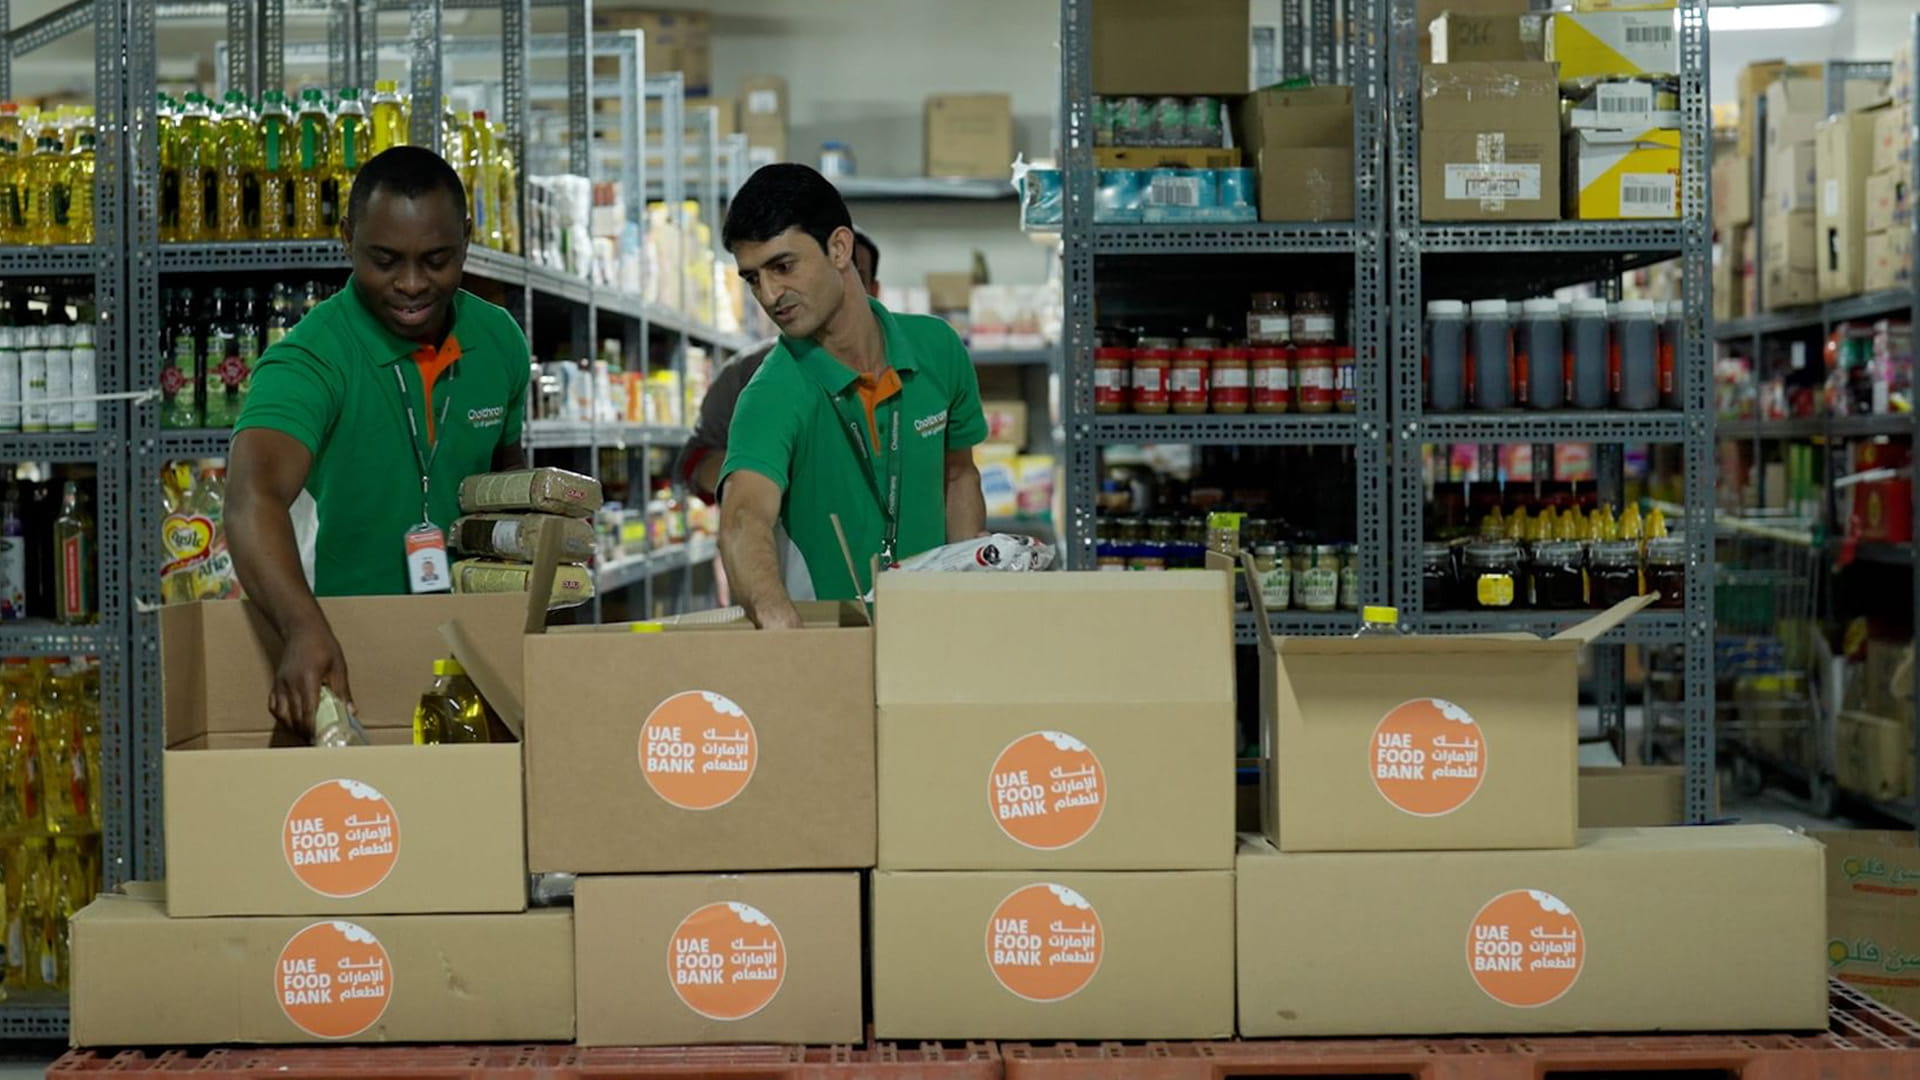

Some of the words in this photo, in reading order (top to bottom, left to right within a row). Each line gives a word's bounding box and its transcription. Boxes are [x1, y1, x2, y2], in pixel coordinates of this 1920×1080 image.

[648, 726, 682, 743] UAE
[703, 728, 749, 743] بنك
[1378, 733, 1412, 749] UAE
[1433, 735, 1478, 750] بنك
[648, 742, 696, 758] FOOD
[702, 742, 749, 761] الإمارات
[1378, 748, 1425, 764] FOOD
[1432, 749, 1478, 767] الإمارات
[648, 757, 694, 773] BANK
[702, 758, 748, 773] للطعام
[1377, 763, 1424, 780] BANK
[1432, 764, 1478, 780] للطعام
[994, 770, 1029, 791] UAE
[1050, 765, 1095, 783] بنك
[997, 784, 1045, 806] FOOD
[1051, 775, 1097, 798] الإمارات
[999, 798, 1047, 819] BANK
[1054, 791, 1099, 812] للطعام
[290, 818, 324, 836] UAE
[345, 813, 390, 827] بنك
[292, 832, 339, 852] FOOD
[346, 824, 391, 846] الإمارات
[293, 846, 341, 866] BANK
[348, 840, 393, 859] للطعام
[995, 919, 1028, 935] UAE
[1050, 920, 1095, 936] بنك
[1475, 925, 1509, 942] UAE
[1530, 927, 1576, 942] بنك
[676, 938, 709, 956] UAE
[731, 938, 776, 954] بنك
[994, 935, 1042, 951] FOOD
[1048, 935, 1095, 953] الإمارات
[1475, 940, 1523, 957] FOOD
[1530, 940, 1576, 959] الإمارات
[338, 957, 383, 969] بنك
[676, 953, 724, 971] FOOD
[731, 951, 777, 970] الإمارات
[994, 950, 1041, 965] BANK
[1049, 950, 1094, 965] للطعام
[1475, 955, 1522, 971] BANK
[1530, 956, 1575, 970] للطعام
[283, 958, 316, 976] UAE
[732, 966, 777, 982] للطعام
[284, 974, 331, 990] FOOD
[338, 968, 384, 989] الإمارات
[677, 968, 724, 984] BANK
[285, 987, 331, 1004] BANK
[340, 985, 384, 1000] للطعام
